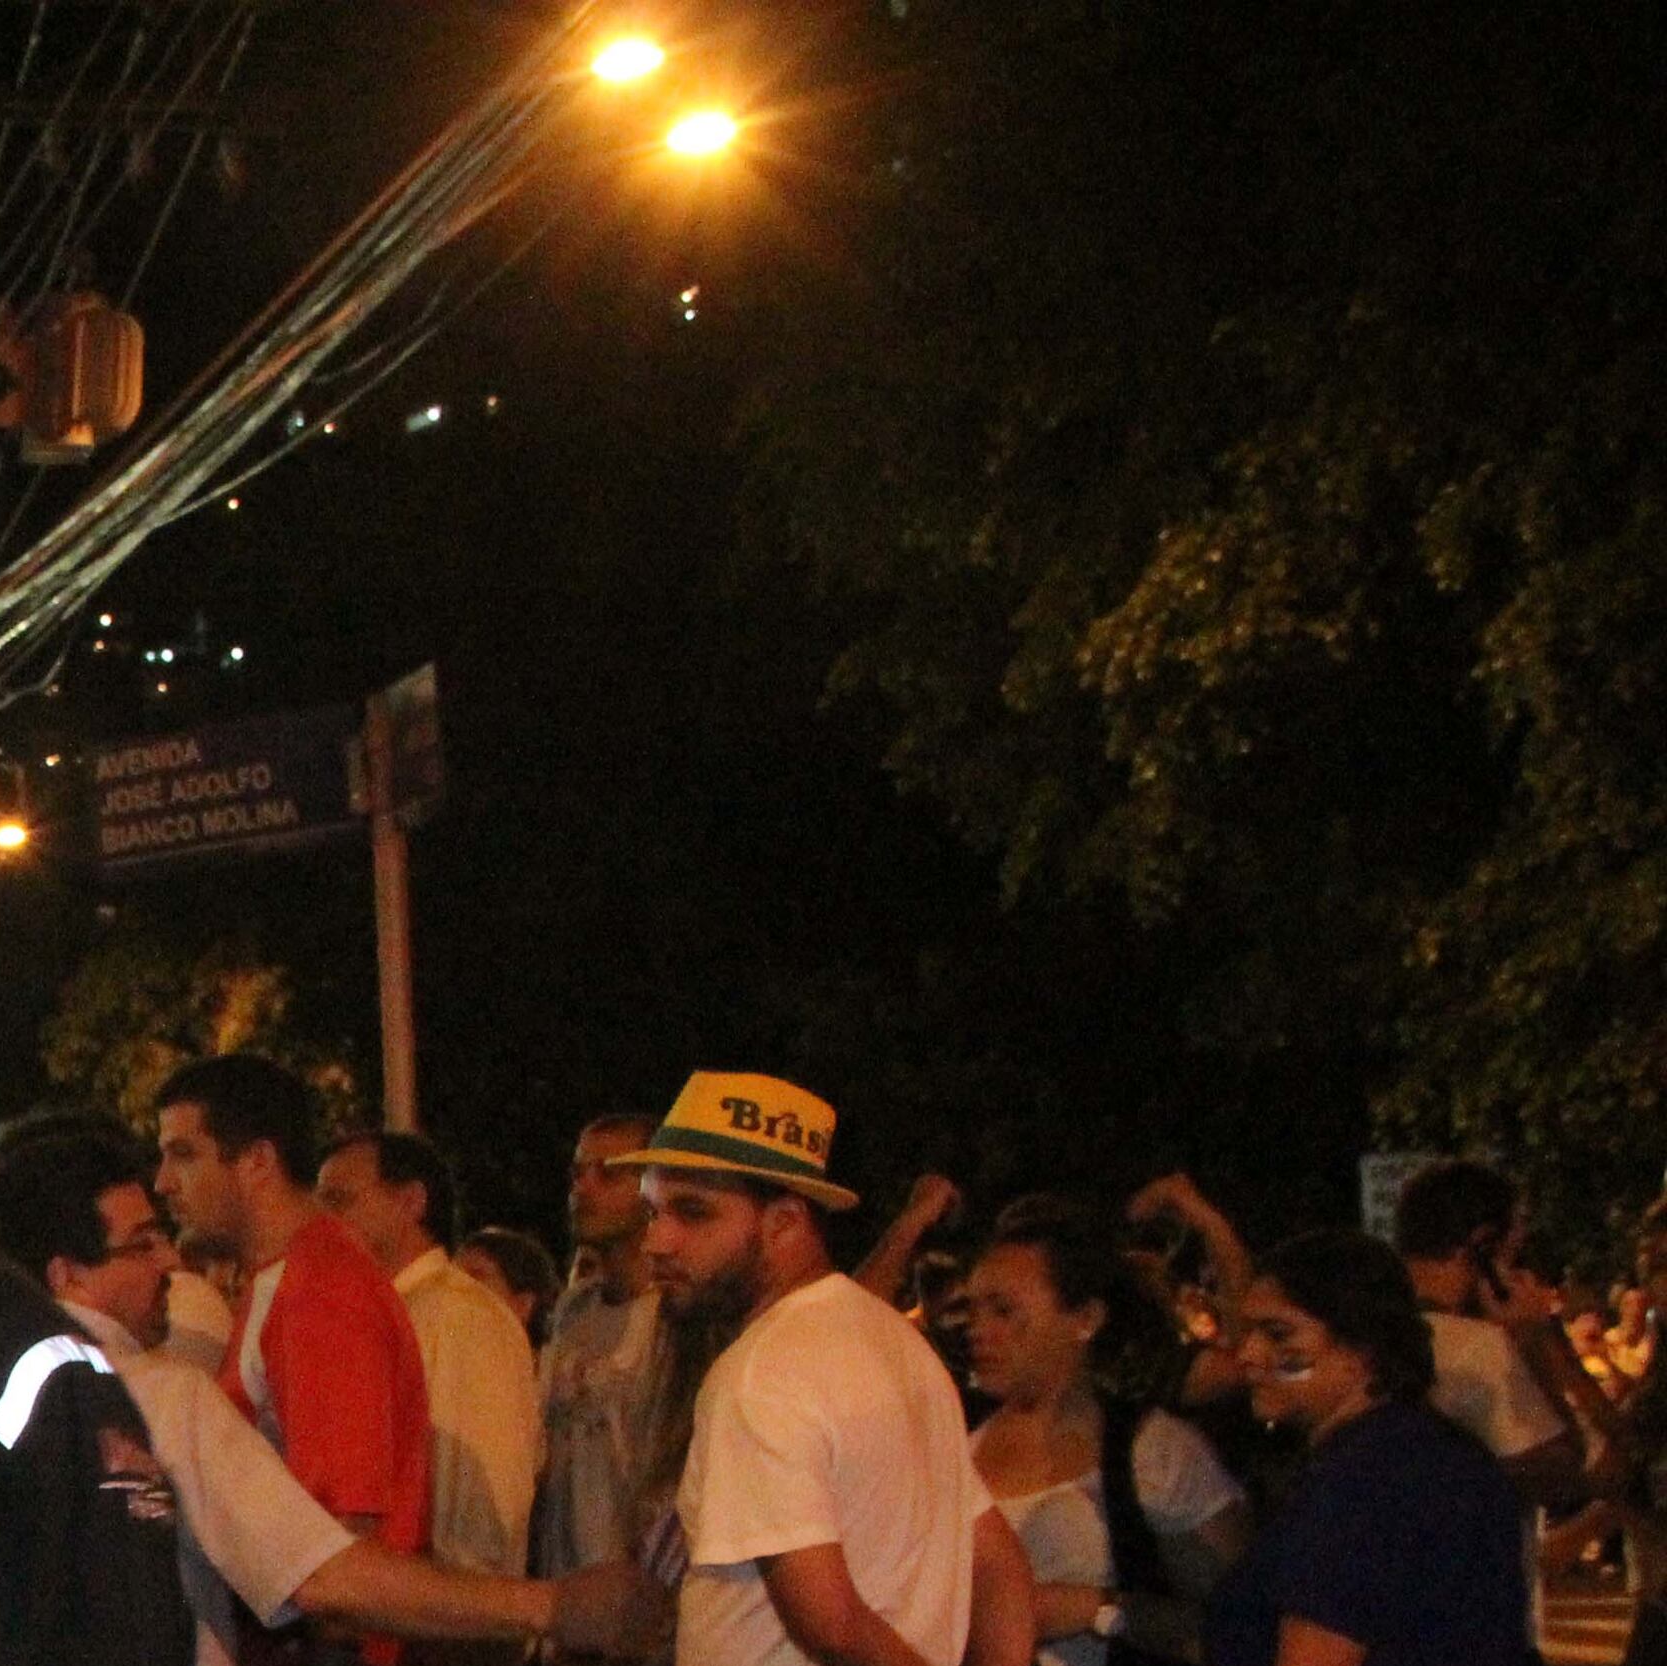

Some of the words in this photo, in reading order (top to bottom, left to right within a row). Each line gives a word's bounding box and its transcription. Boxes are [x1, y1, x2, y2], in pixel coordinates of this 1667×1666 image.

[95, 737, 202, 781] AVENIDA
[170, 761, 272, 802] ADOLFO
[100, 813, 196, 855] BIANCO
[201, 798, 300, 836] MOLINA
[720, 1097, 826, 1153] Bras
